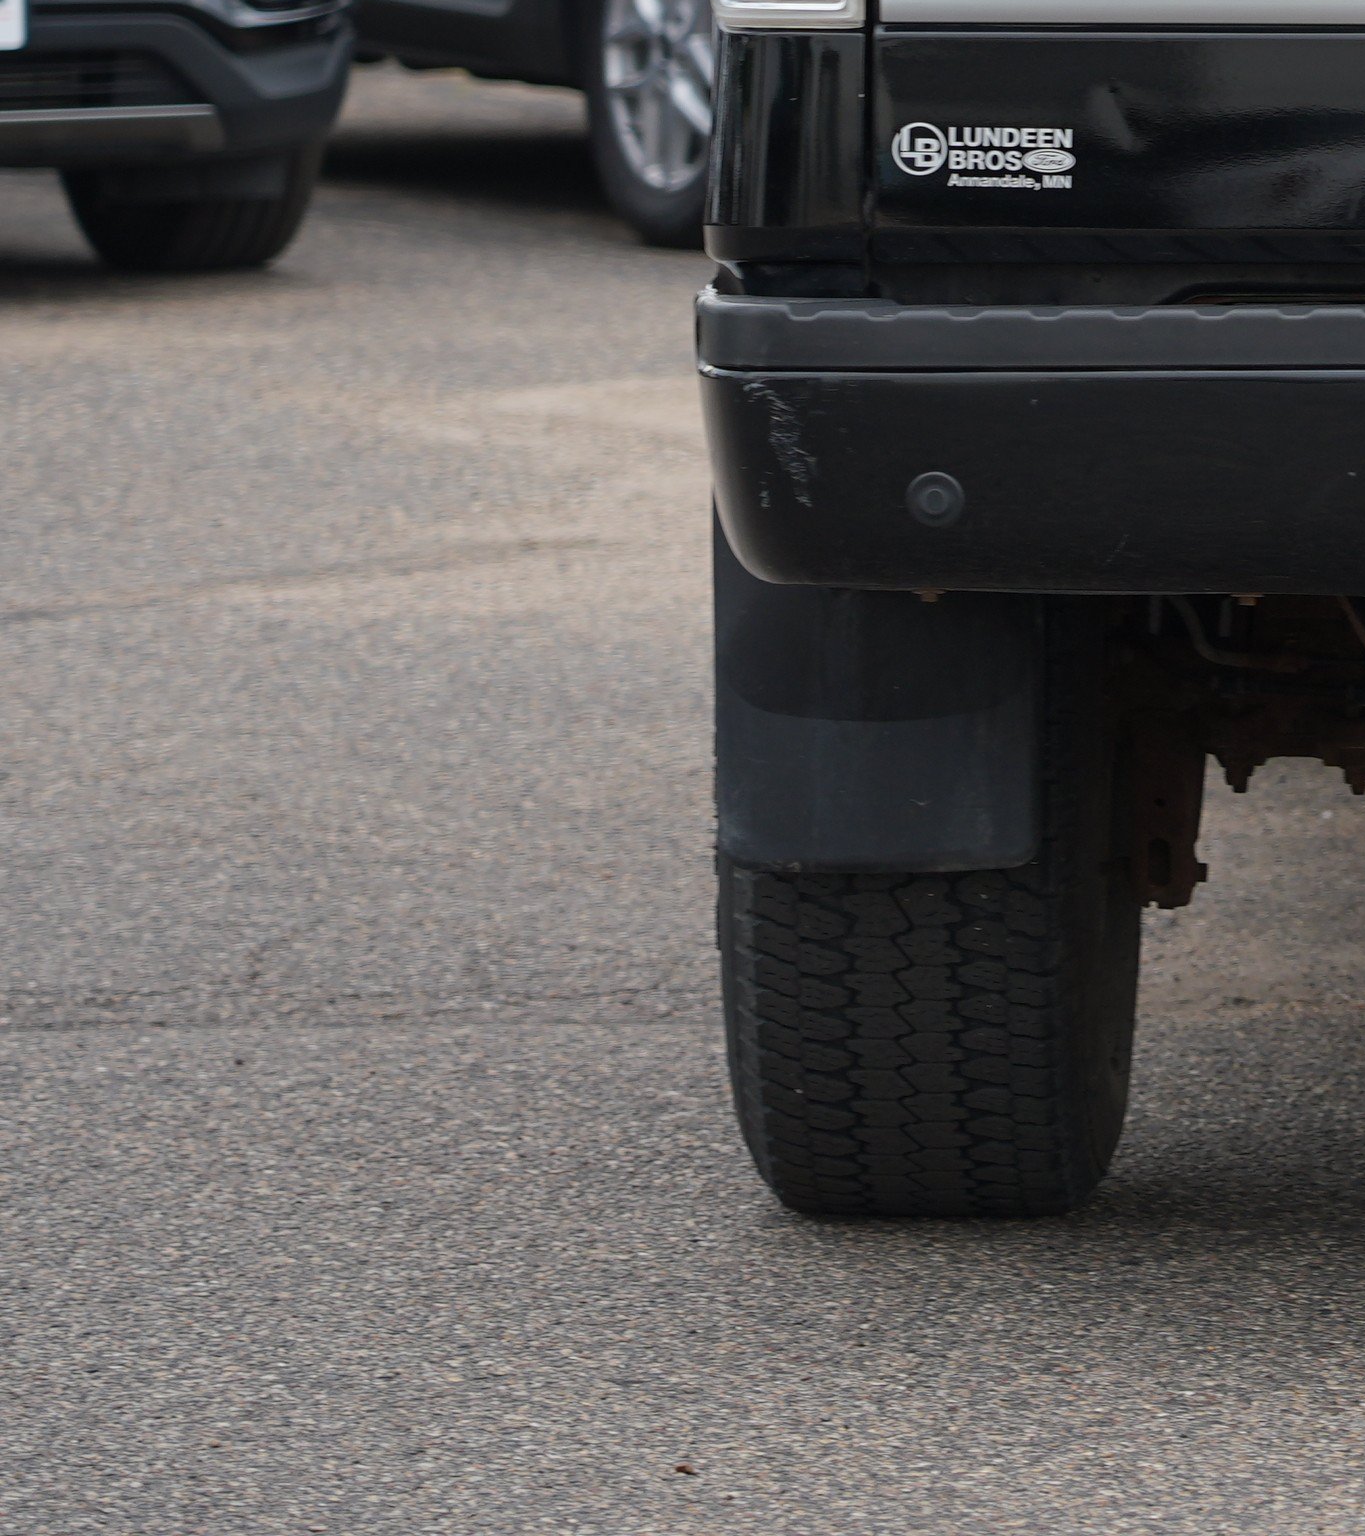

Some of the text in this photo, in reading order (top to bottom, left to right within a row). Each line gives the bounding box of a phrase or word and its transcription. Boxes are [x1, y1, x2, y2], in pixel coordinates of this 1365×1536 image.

[948, 126, 1074, 149] LUNDEEN
[948, 150, 1023, 171] BROS
[1042, 175, 1073, 189] MN
